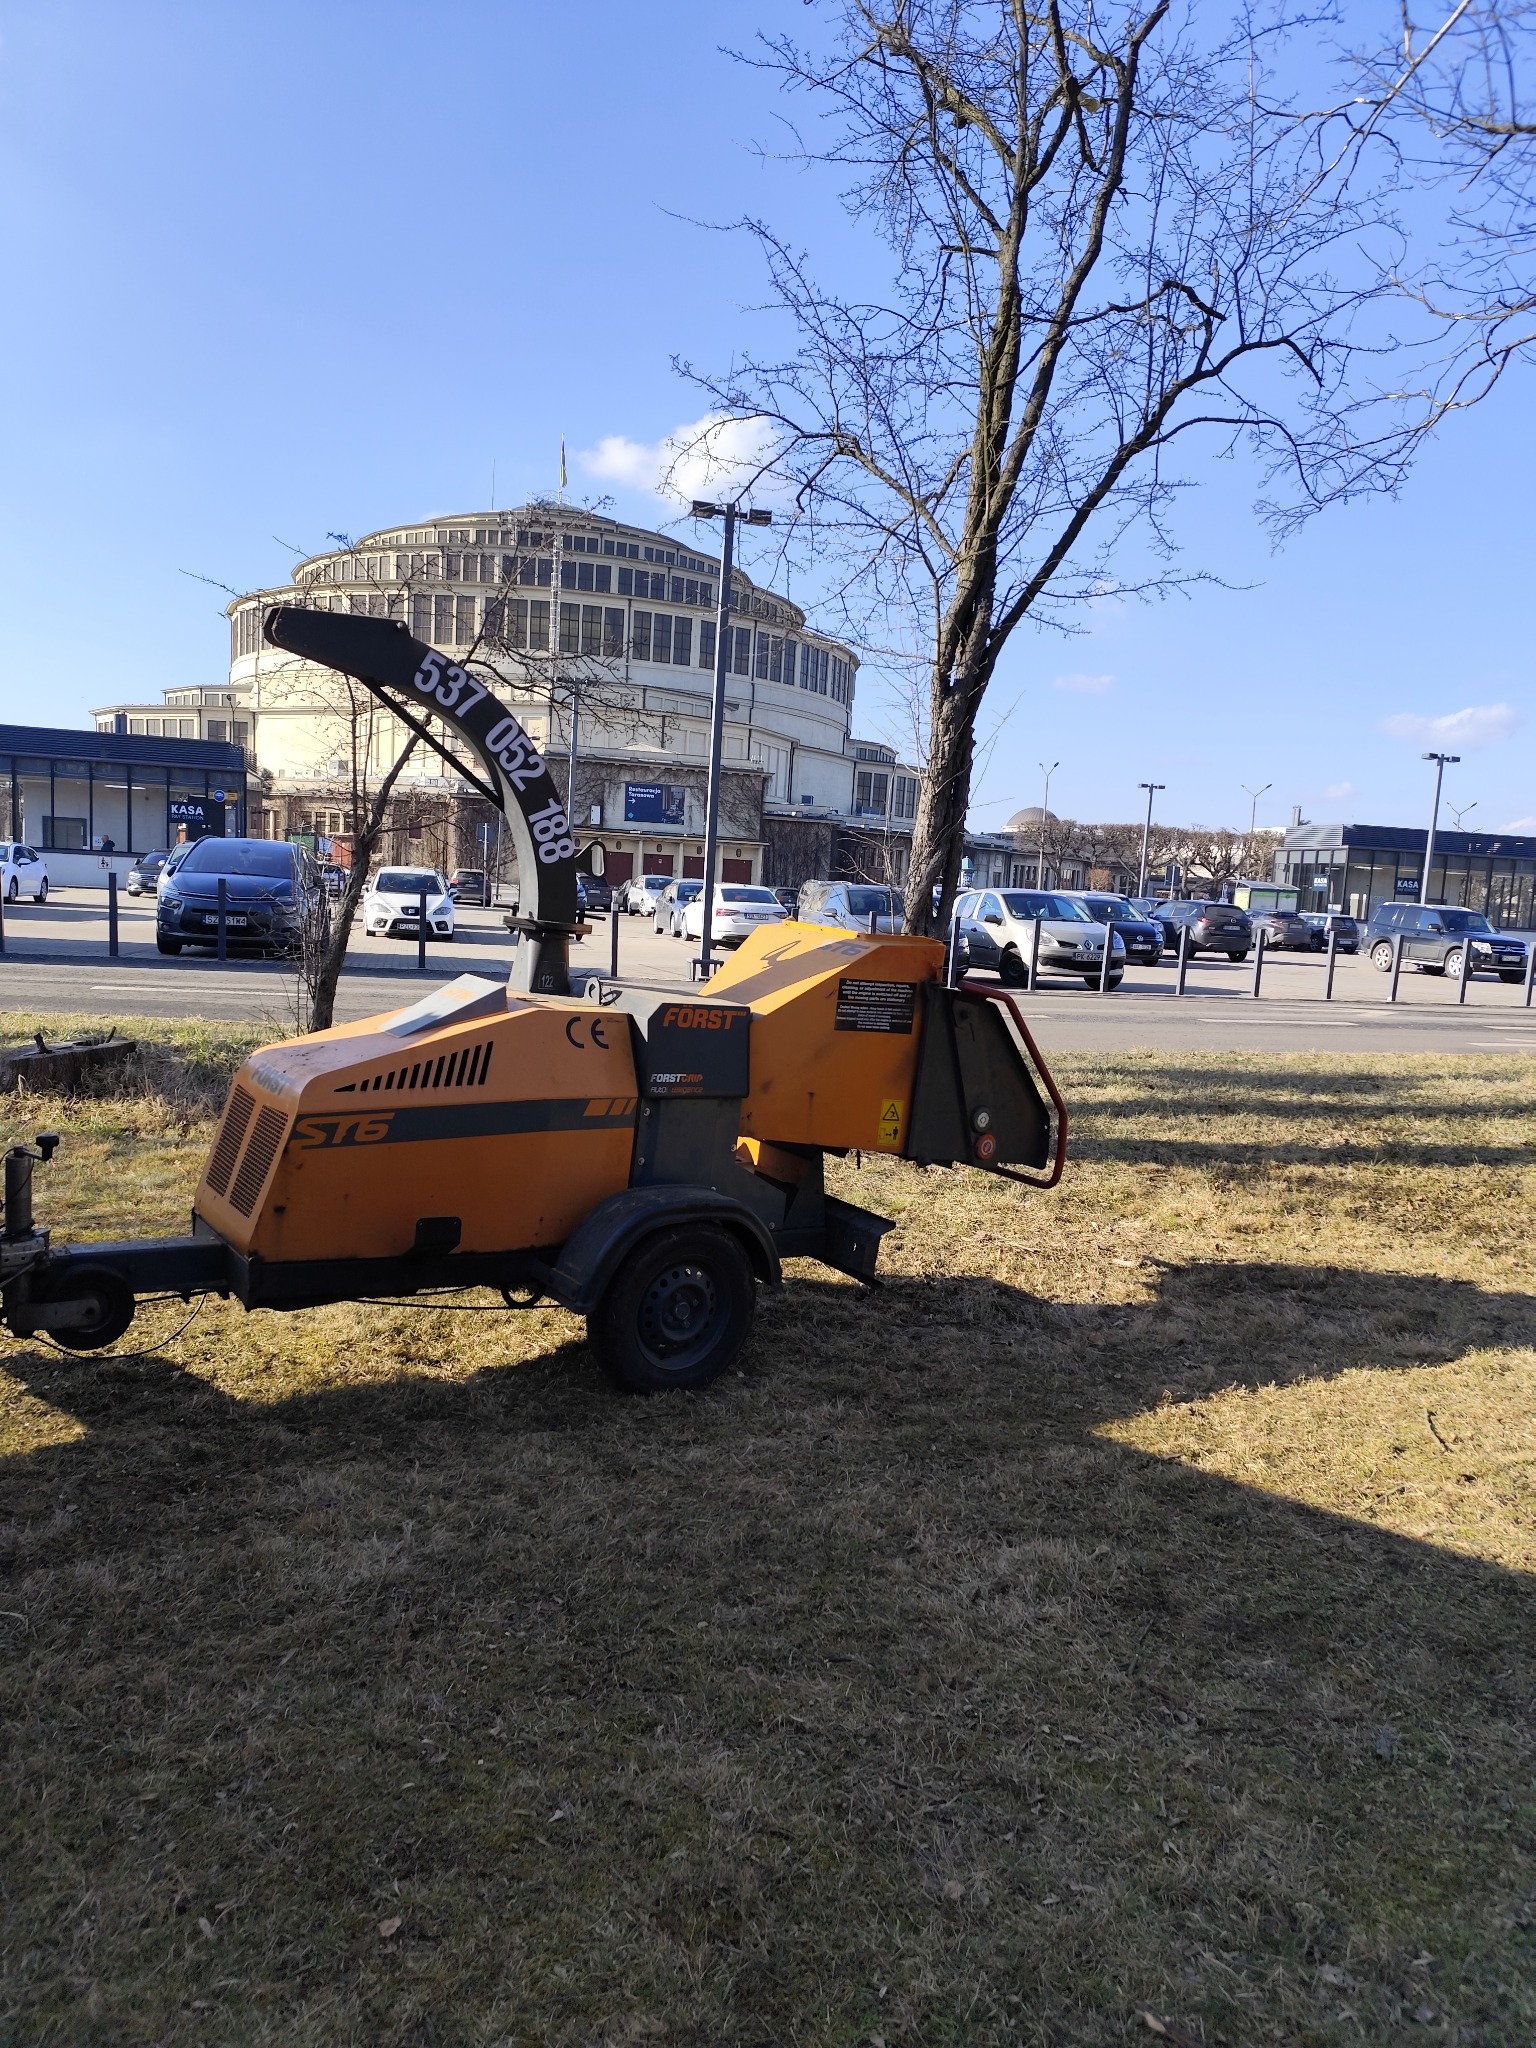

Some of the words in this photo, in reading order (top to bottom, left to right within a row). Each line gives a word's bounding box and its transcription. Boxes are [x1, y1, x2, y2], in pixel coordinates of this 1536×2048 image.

[413, 649, 489, 718] 537
[485, 716, 546, 792] 052
[527, 798, 574, 864] 188
[628, 786, 662, 794] Restauracja
[171, 804, 204, 816] KASA
[1397, 880, 1419, 888] KASA
[541, 974, 554, 988] 122
[663, 1004, 738, 1030] FÖRST
[565, 1016, 609, 1049] CE
[290, 1112, 395, 1147] ST6
